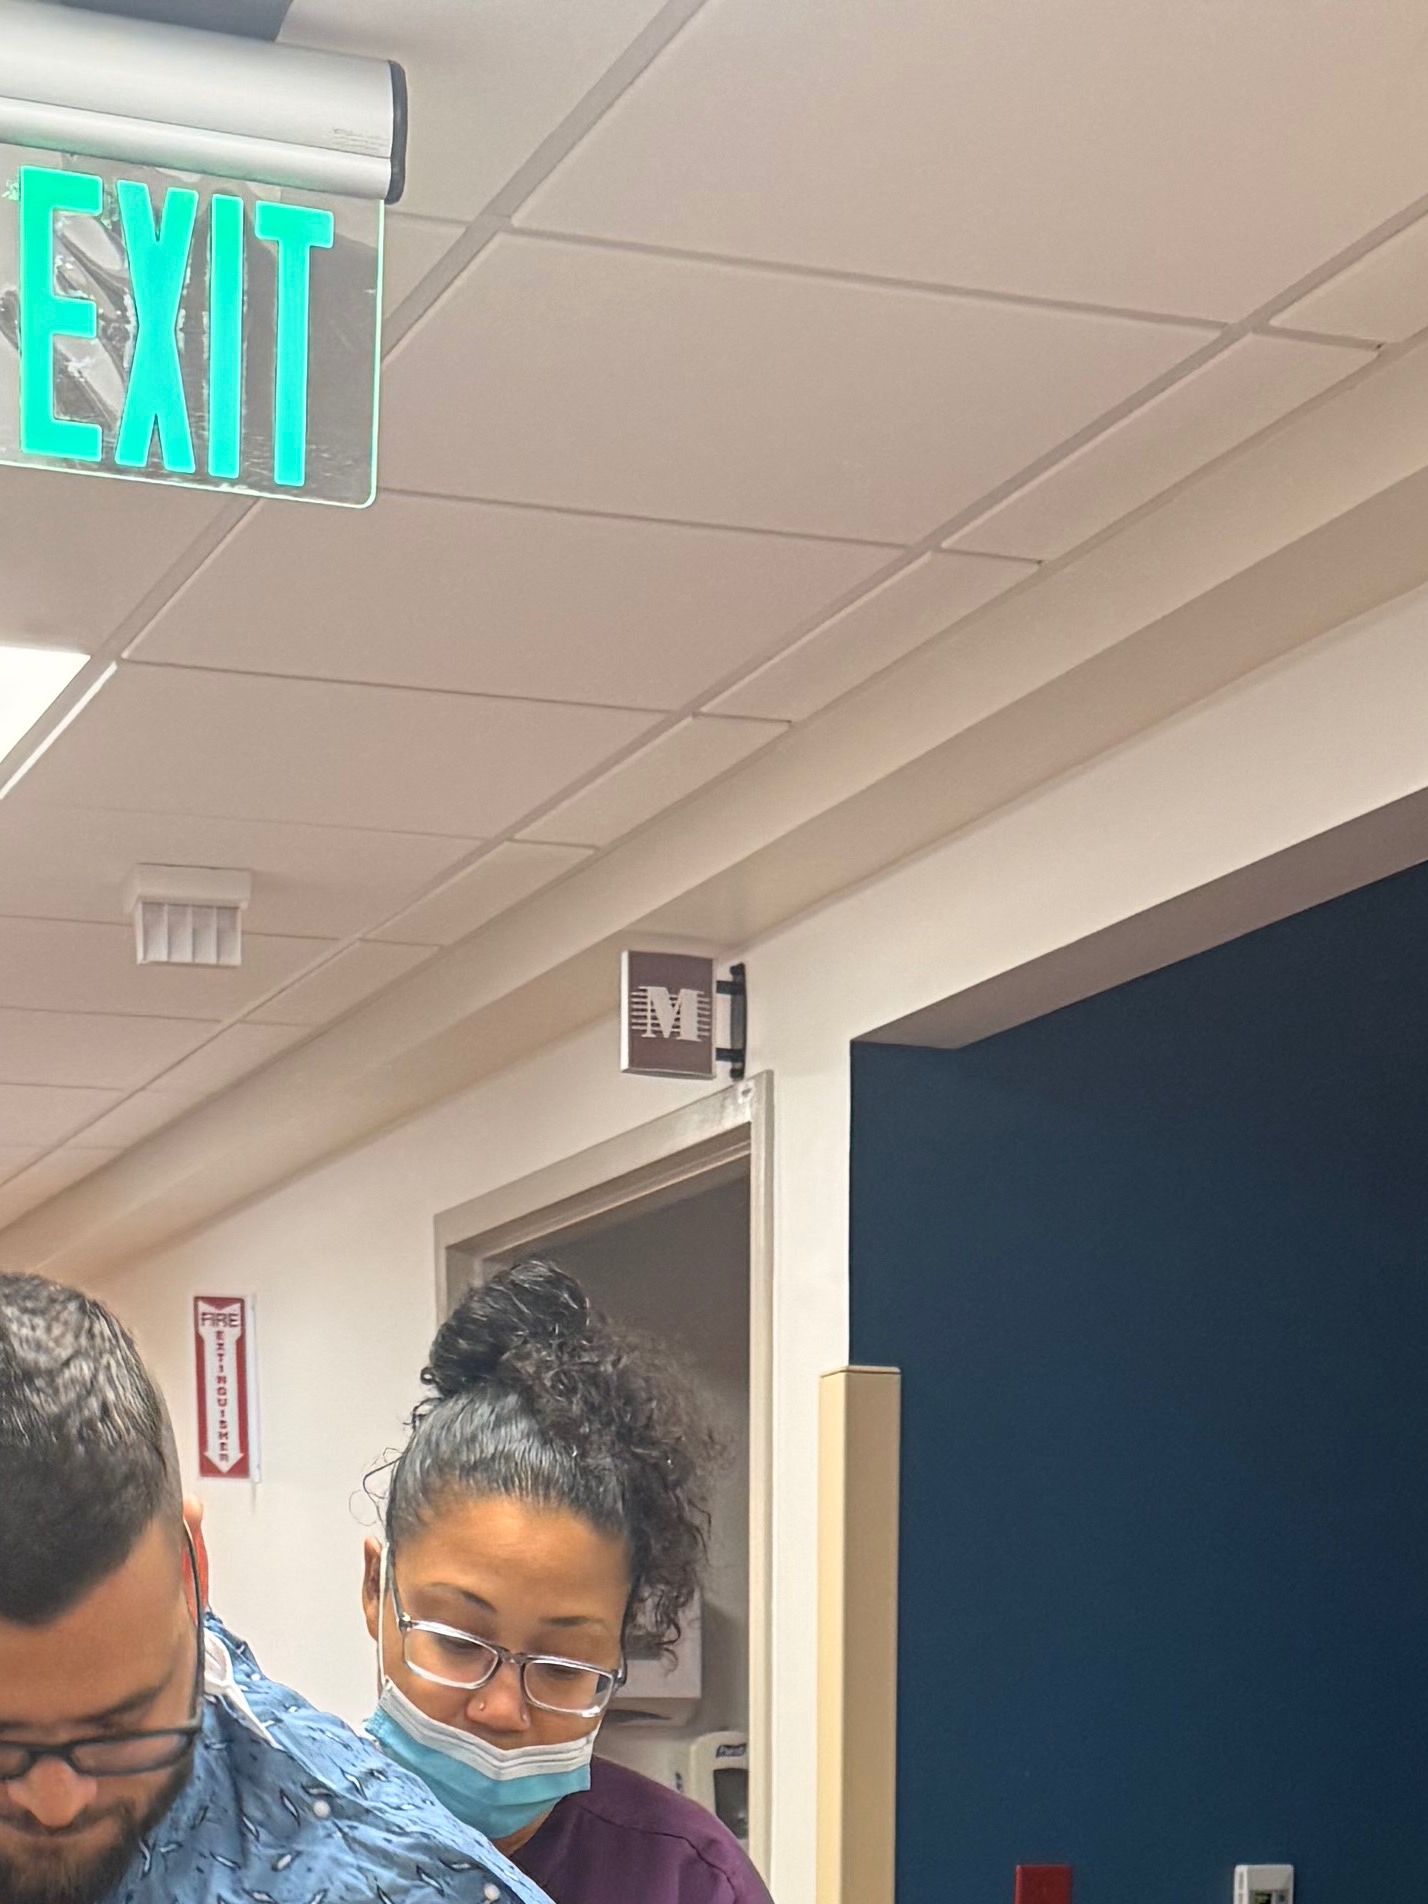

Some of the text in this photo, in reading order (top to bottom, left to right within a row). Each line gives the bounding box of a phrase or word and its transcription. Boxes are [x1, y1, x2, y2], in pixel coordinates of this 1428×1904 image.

[19, 164, 335, 488] EXIT
[636, 984, 707, 1042] M
[199, 1311, 241, 1329] FIRE
[213, 1330, 231, 1464] EXTINGUISHER
